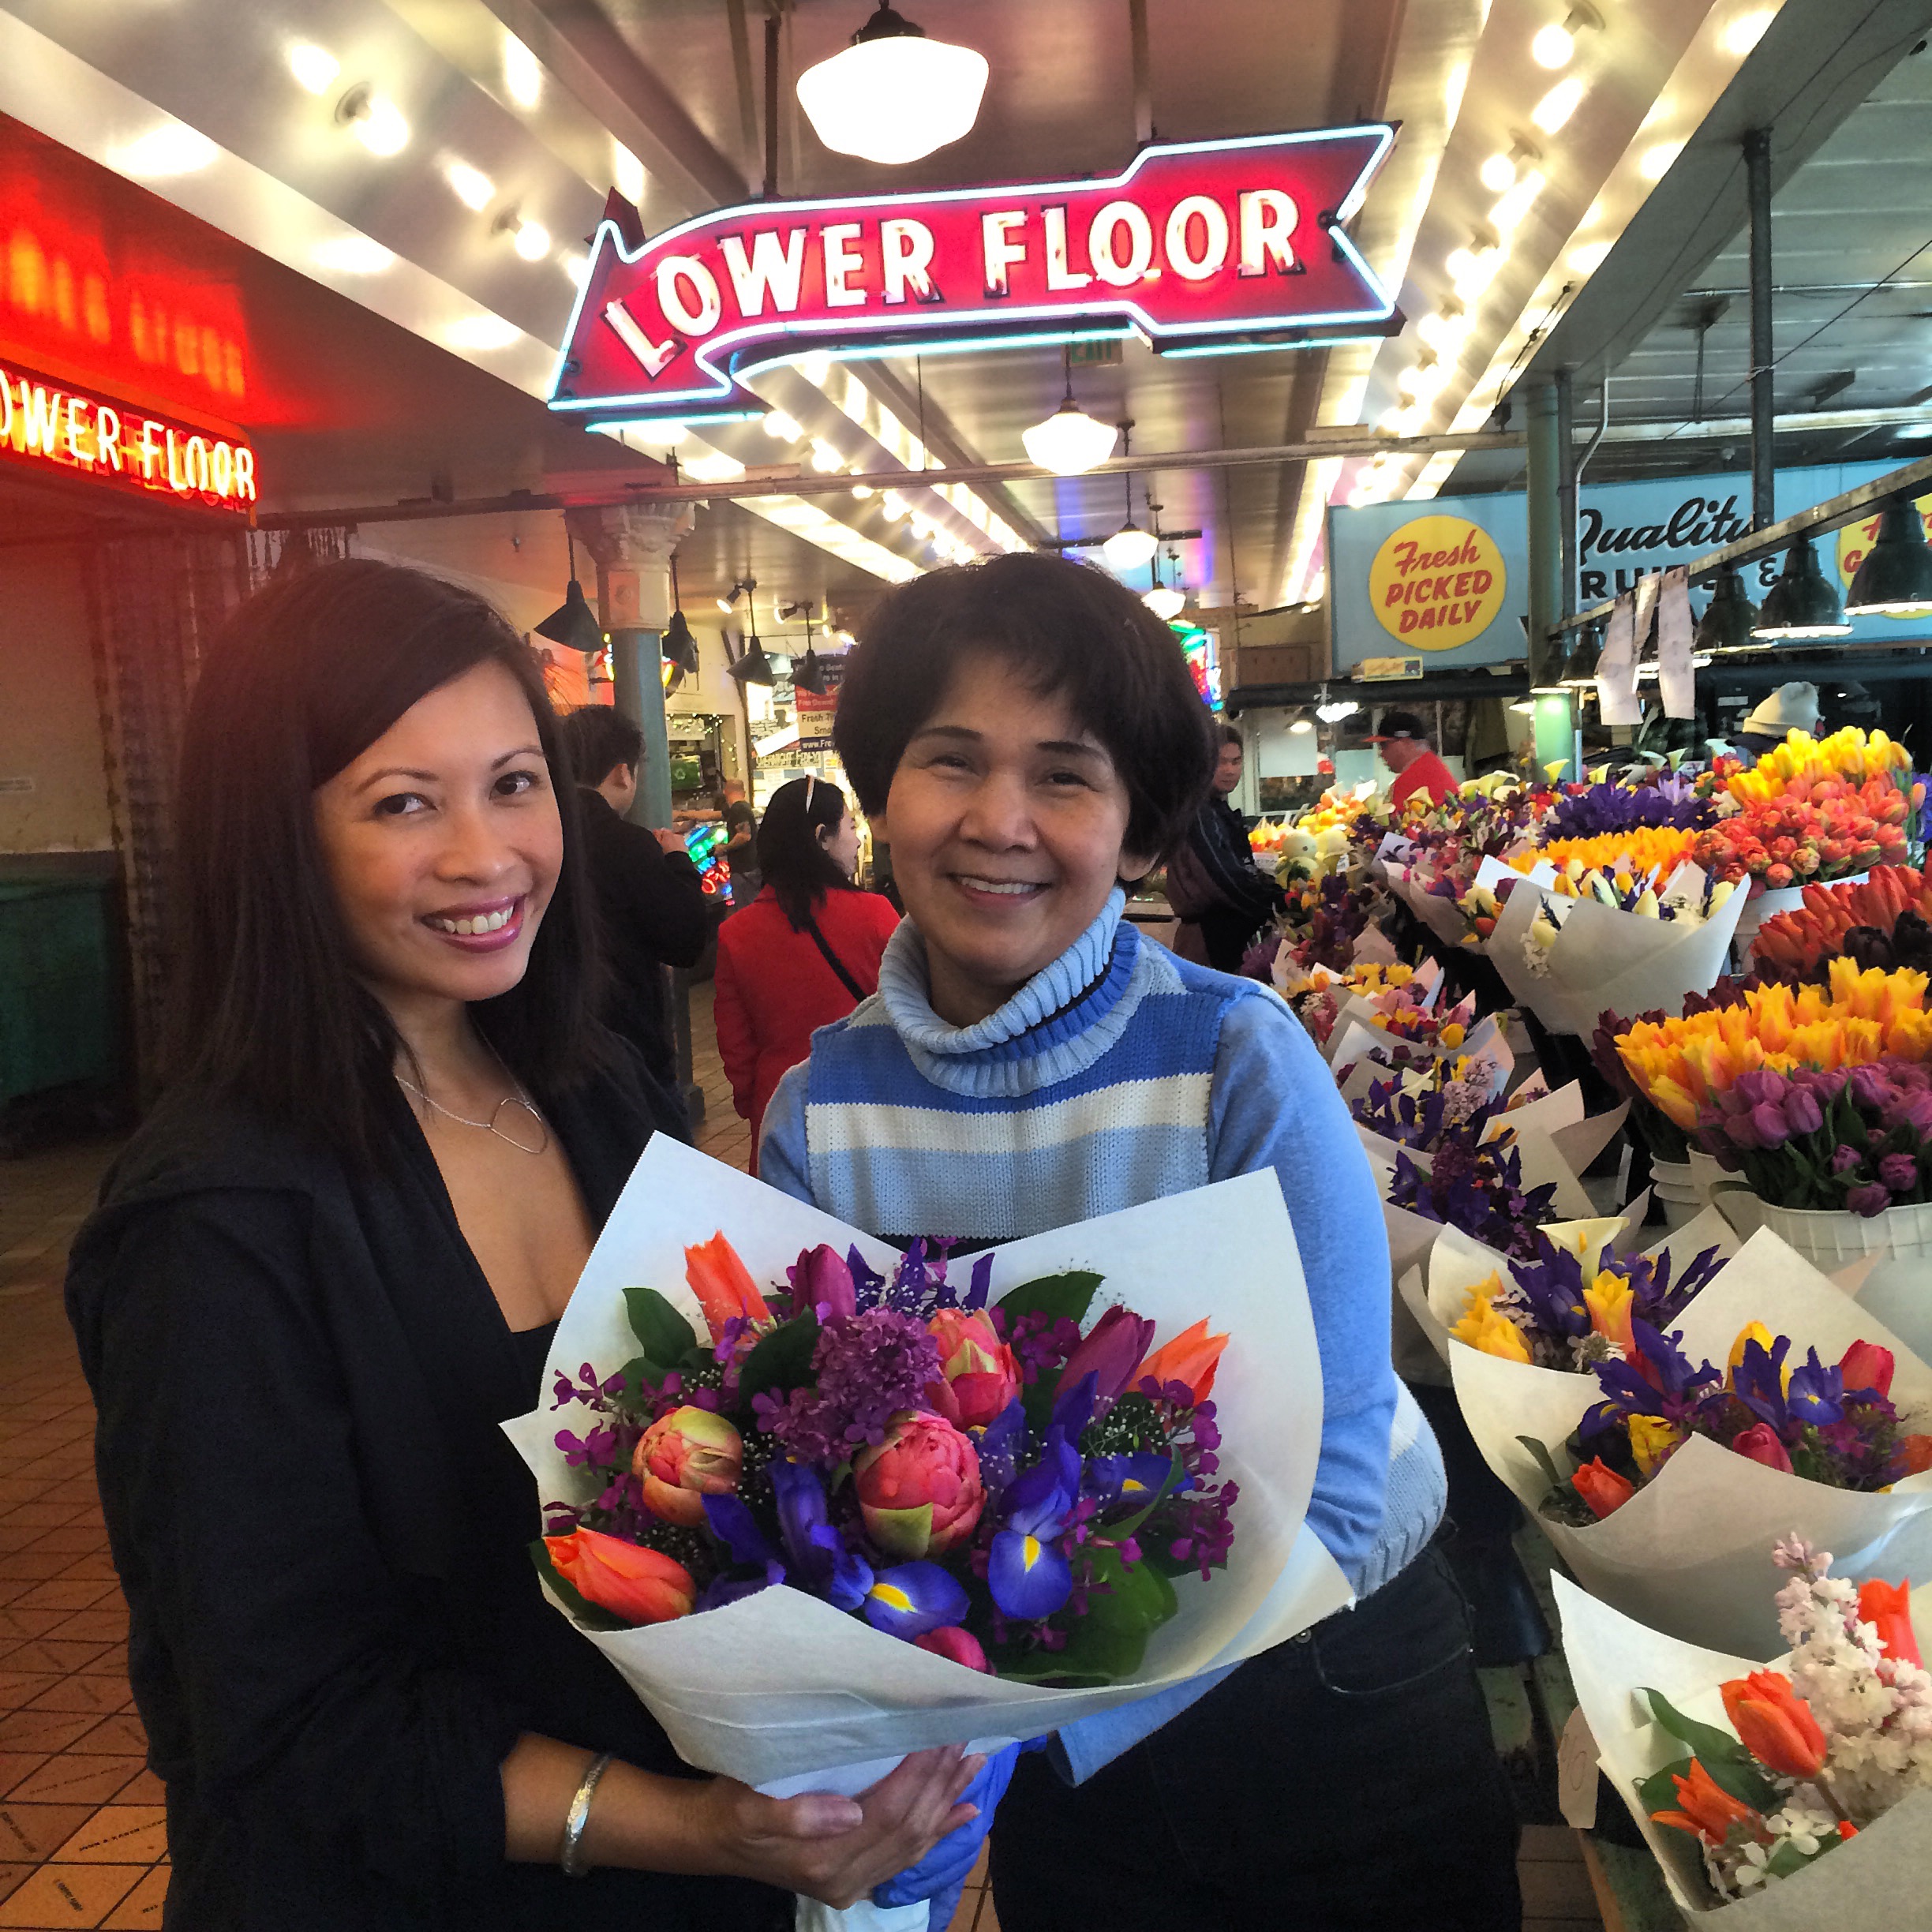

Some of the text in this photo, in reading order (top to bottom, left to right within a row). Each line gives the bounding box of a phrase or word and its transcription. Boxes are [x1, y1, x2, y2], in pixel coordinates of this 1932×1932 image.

[601, 189, 1306, 379] LOWER FLOOR
[140, 420, 256, 502] FLOOR
[1393, 529, 1481, 578] Fresh
[1385, 570, 1492, 608] PICKED
[1398, 600, 1482, 634] DAILY
[801, 713, 823, 723] Fresh
[814, 726, 832, 736] Smo
